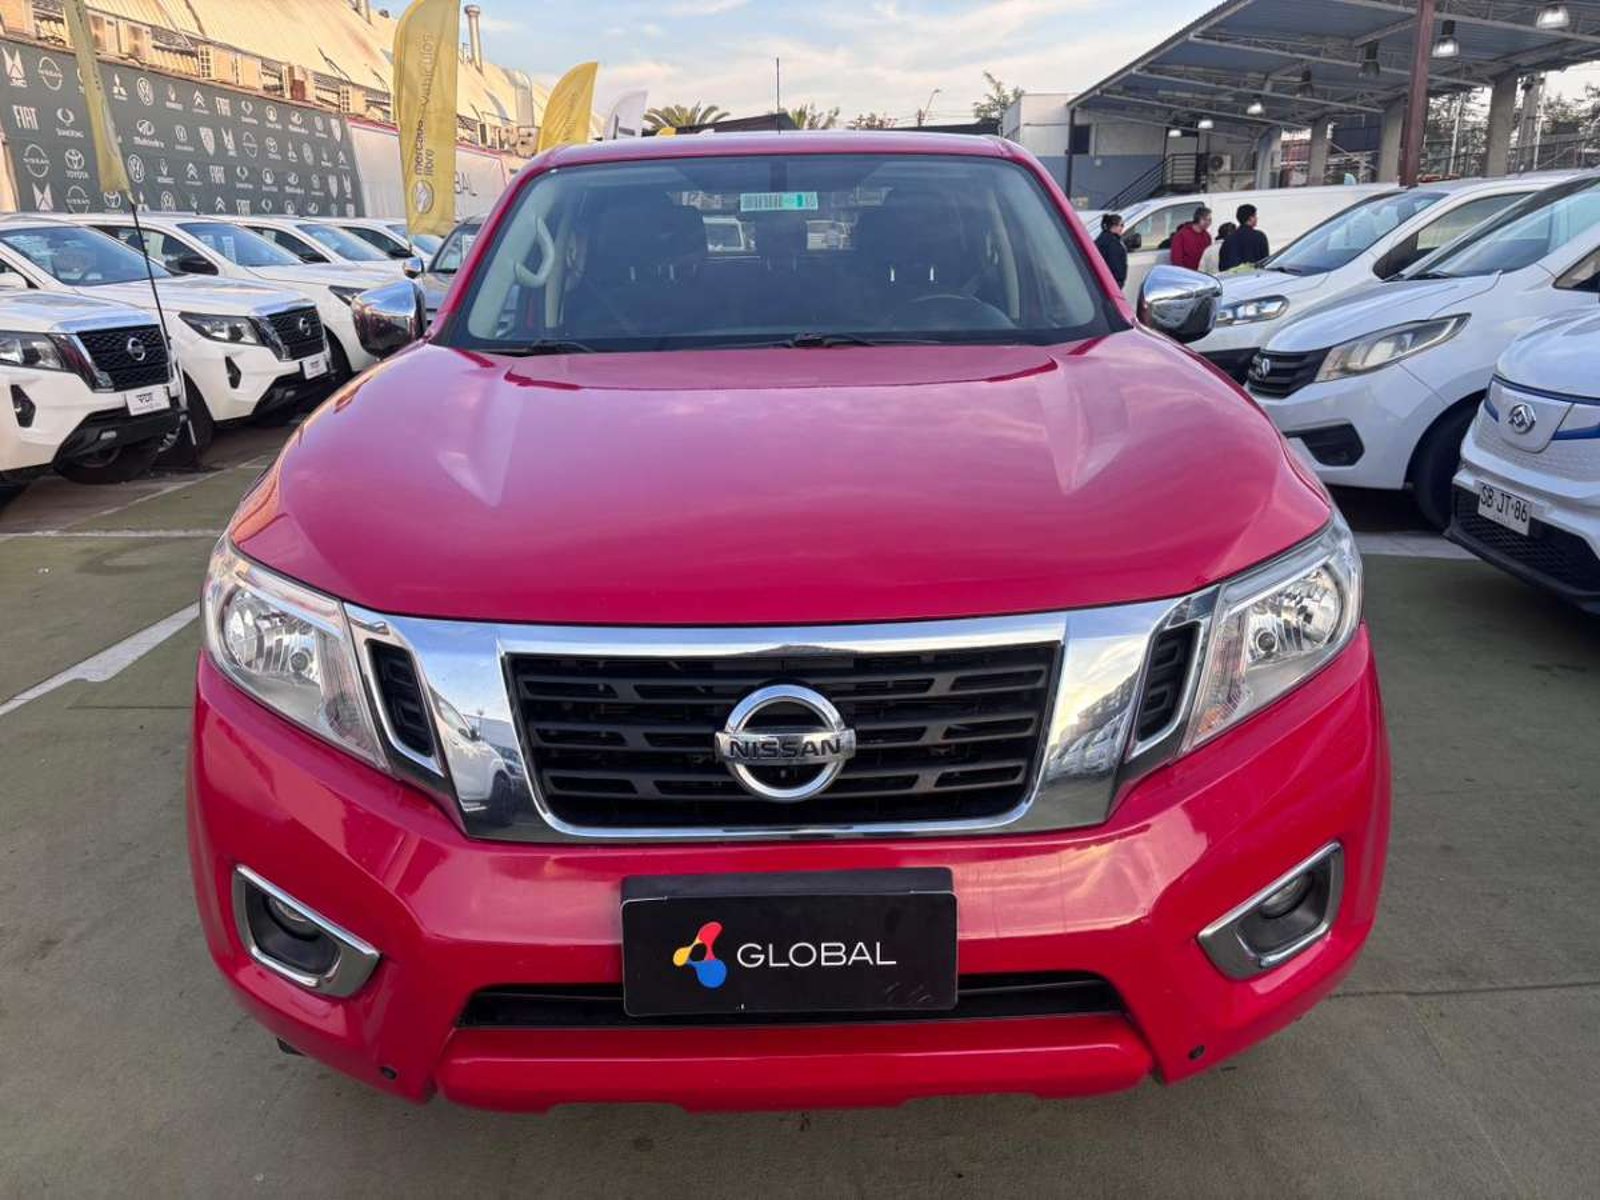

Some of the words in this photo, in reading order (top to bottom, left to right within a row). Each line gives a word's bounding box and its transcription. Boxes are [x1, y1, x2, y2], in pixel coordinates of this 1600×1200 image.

[12, 104, 39, 130] FIAT
[23, 157, 50, 165] NISSAN
[65, 169, 90, 180] TOYOTA
[730, 738, 841, 760] NISSAN
[736, 941, 897, 968] GLOBAL
